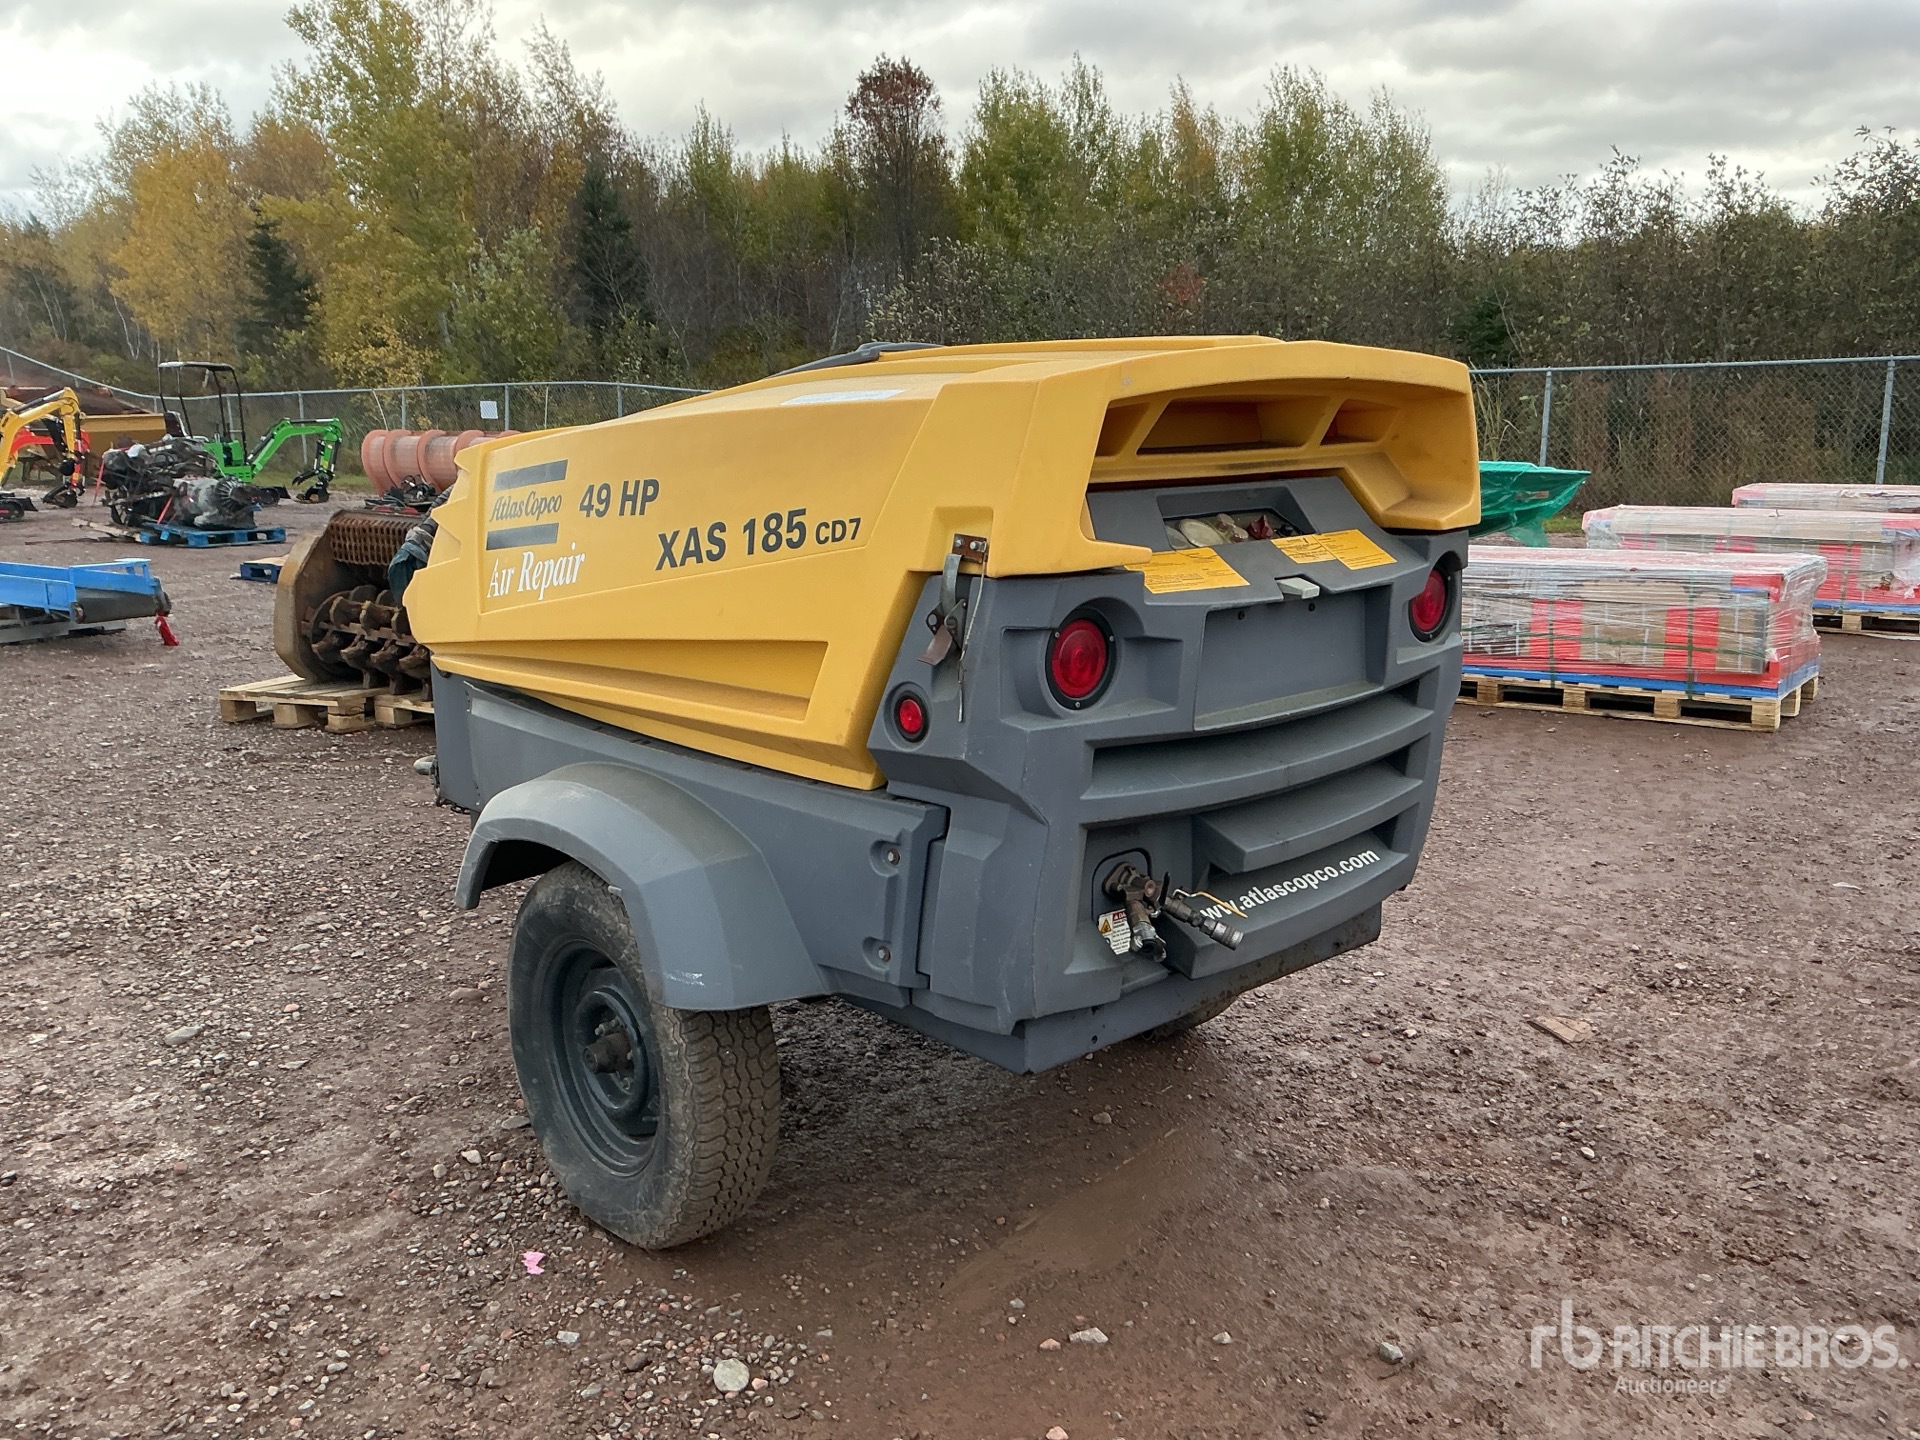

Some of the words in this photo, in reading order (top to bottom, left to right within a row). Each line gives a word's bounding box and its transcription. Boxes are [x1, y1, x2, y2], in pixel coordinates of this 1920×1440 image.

[578, 482, 611, 518] 49
[618, 478, 660, 516] HP
[655, 521, 727, 571] XAS
[742, 508, 807, 555] 185
[815, 517, 862, 545] CD7
[487, 558, 516, 598] Air
[517, 541, 586, 600] Repair
